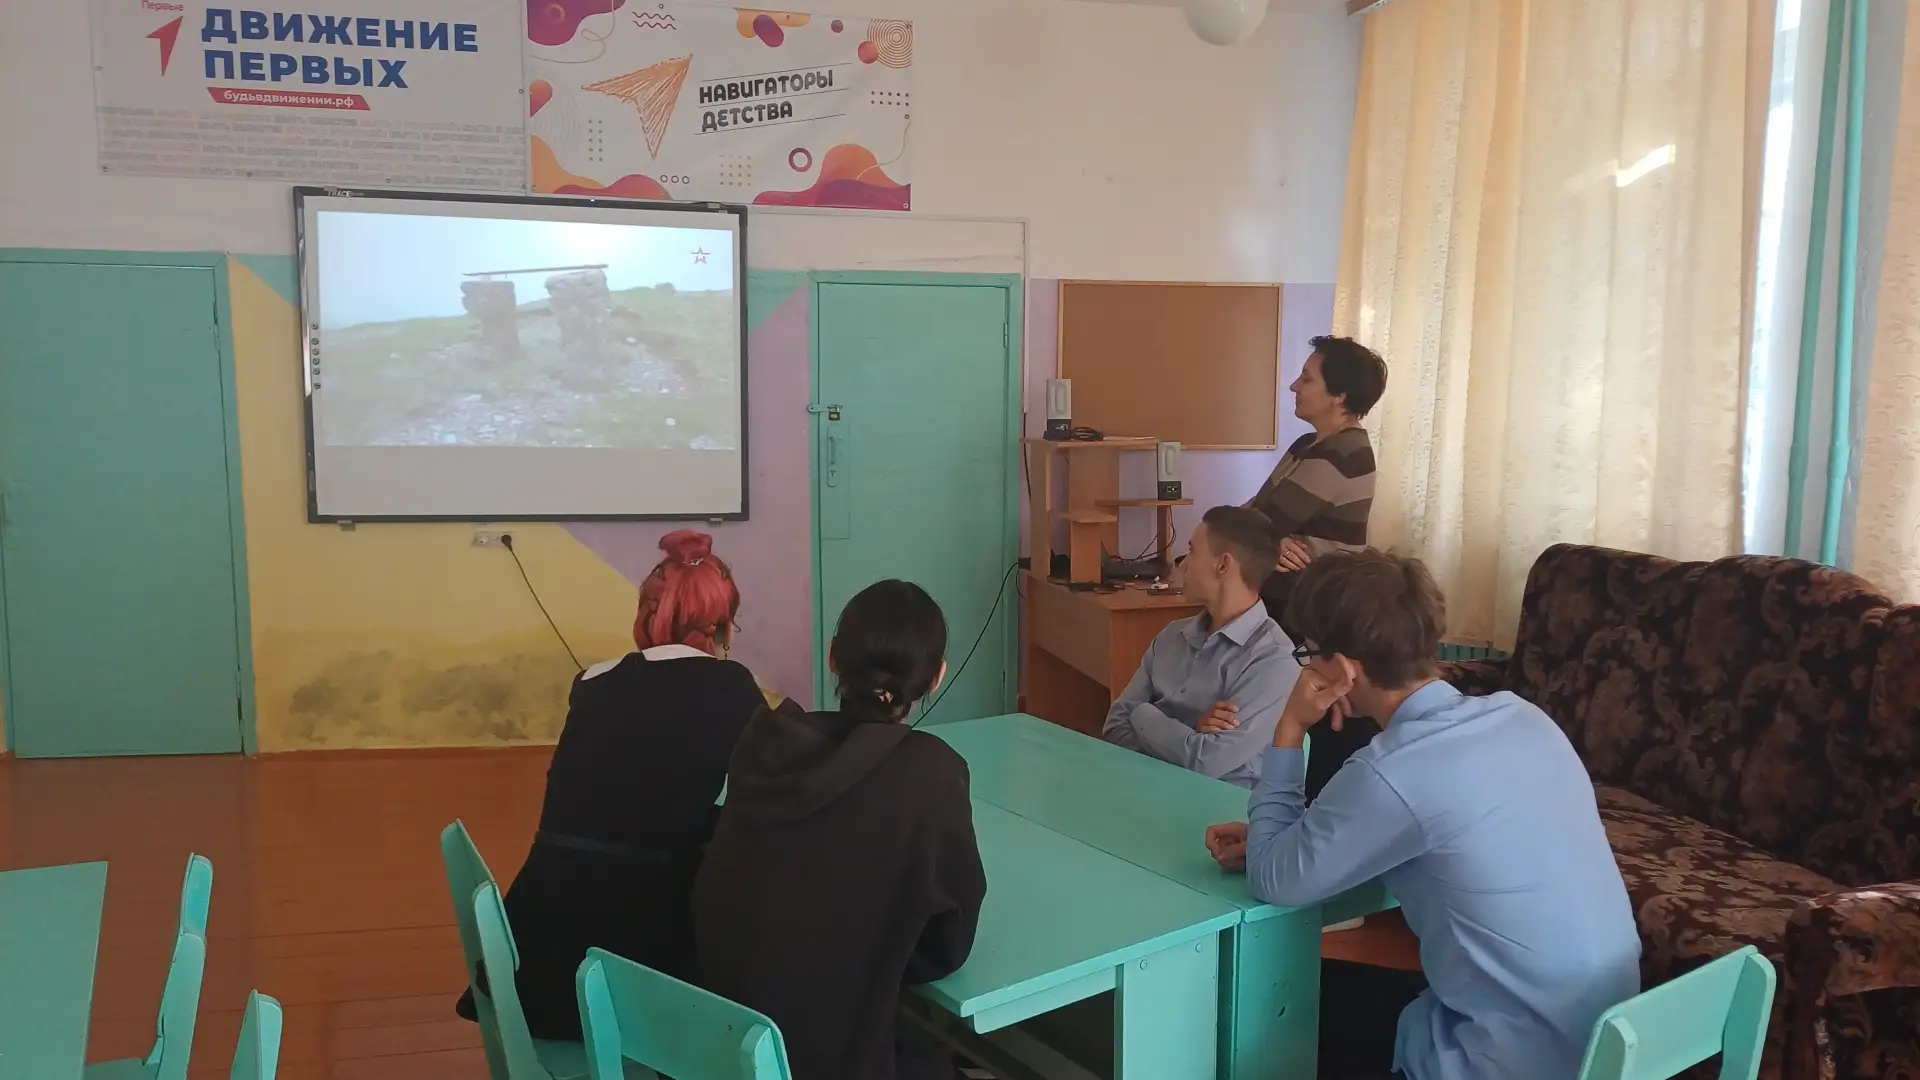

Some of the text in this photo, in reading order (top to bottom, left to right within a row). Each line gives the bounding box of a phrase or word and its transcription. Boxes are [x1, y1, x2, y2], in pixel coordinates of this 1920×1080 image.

[141, 0, 184, 12] Первые
[201, 8, 479, 53] ДВИЖЕНИЕ
[203, 49, 409, 89] ПЕРВЫХ
[223, 90, 354, 108] будьвдвижении.рф
[698, 69, 834, 104] НАВИГАТОРЫ
[701, 101, 793, 132] ДЕТСТВА
